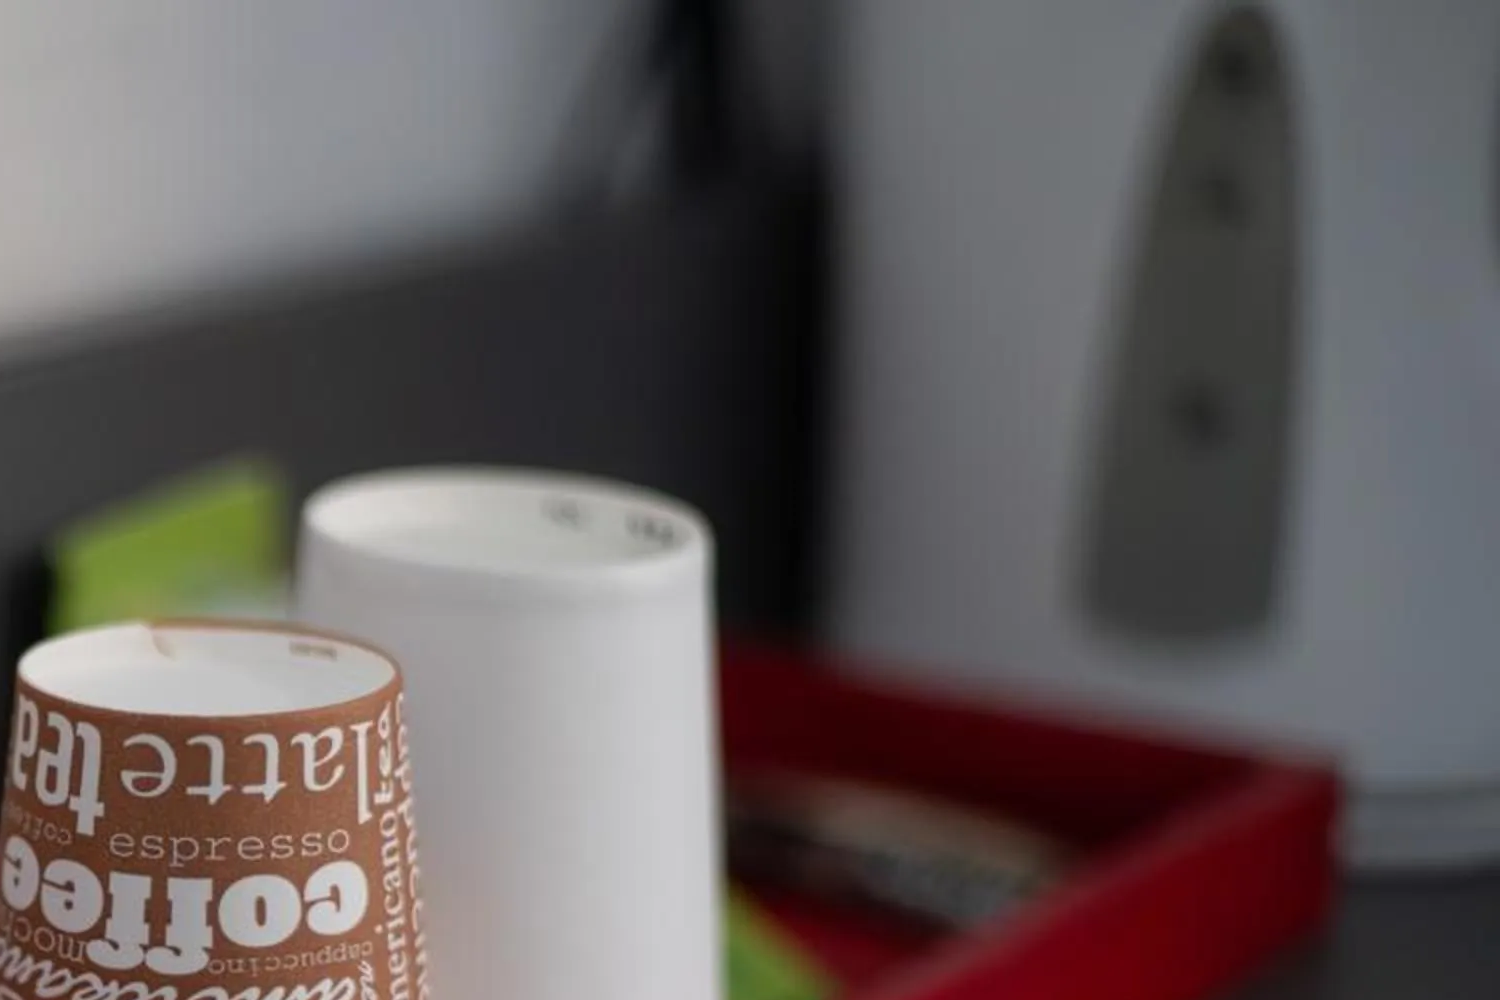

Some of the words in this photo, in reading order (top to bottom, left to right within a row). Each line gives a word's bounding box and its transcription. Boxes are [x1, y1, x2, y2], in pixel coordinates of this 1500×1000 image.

[11, 694, 105, 836] tea
[121, 721, 377, 824] latte
[109, 828, 350, 868] espresso
[1, 835, 370, 976] coffee
[207, 941, 375, 976] cappuccino
